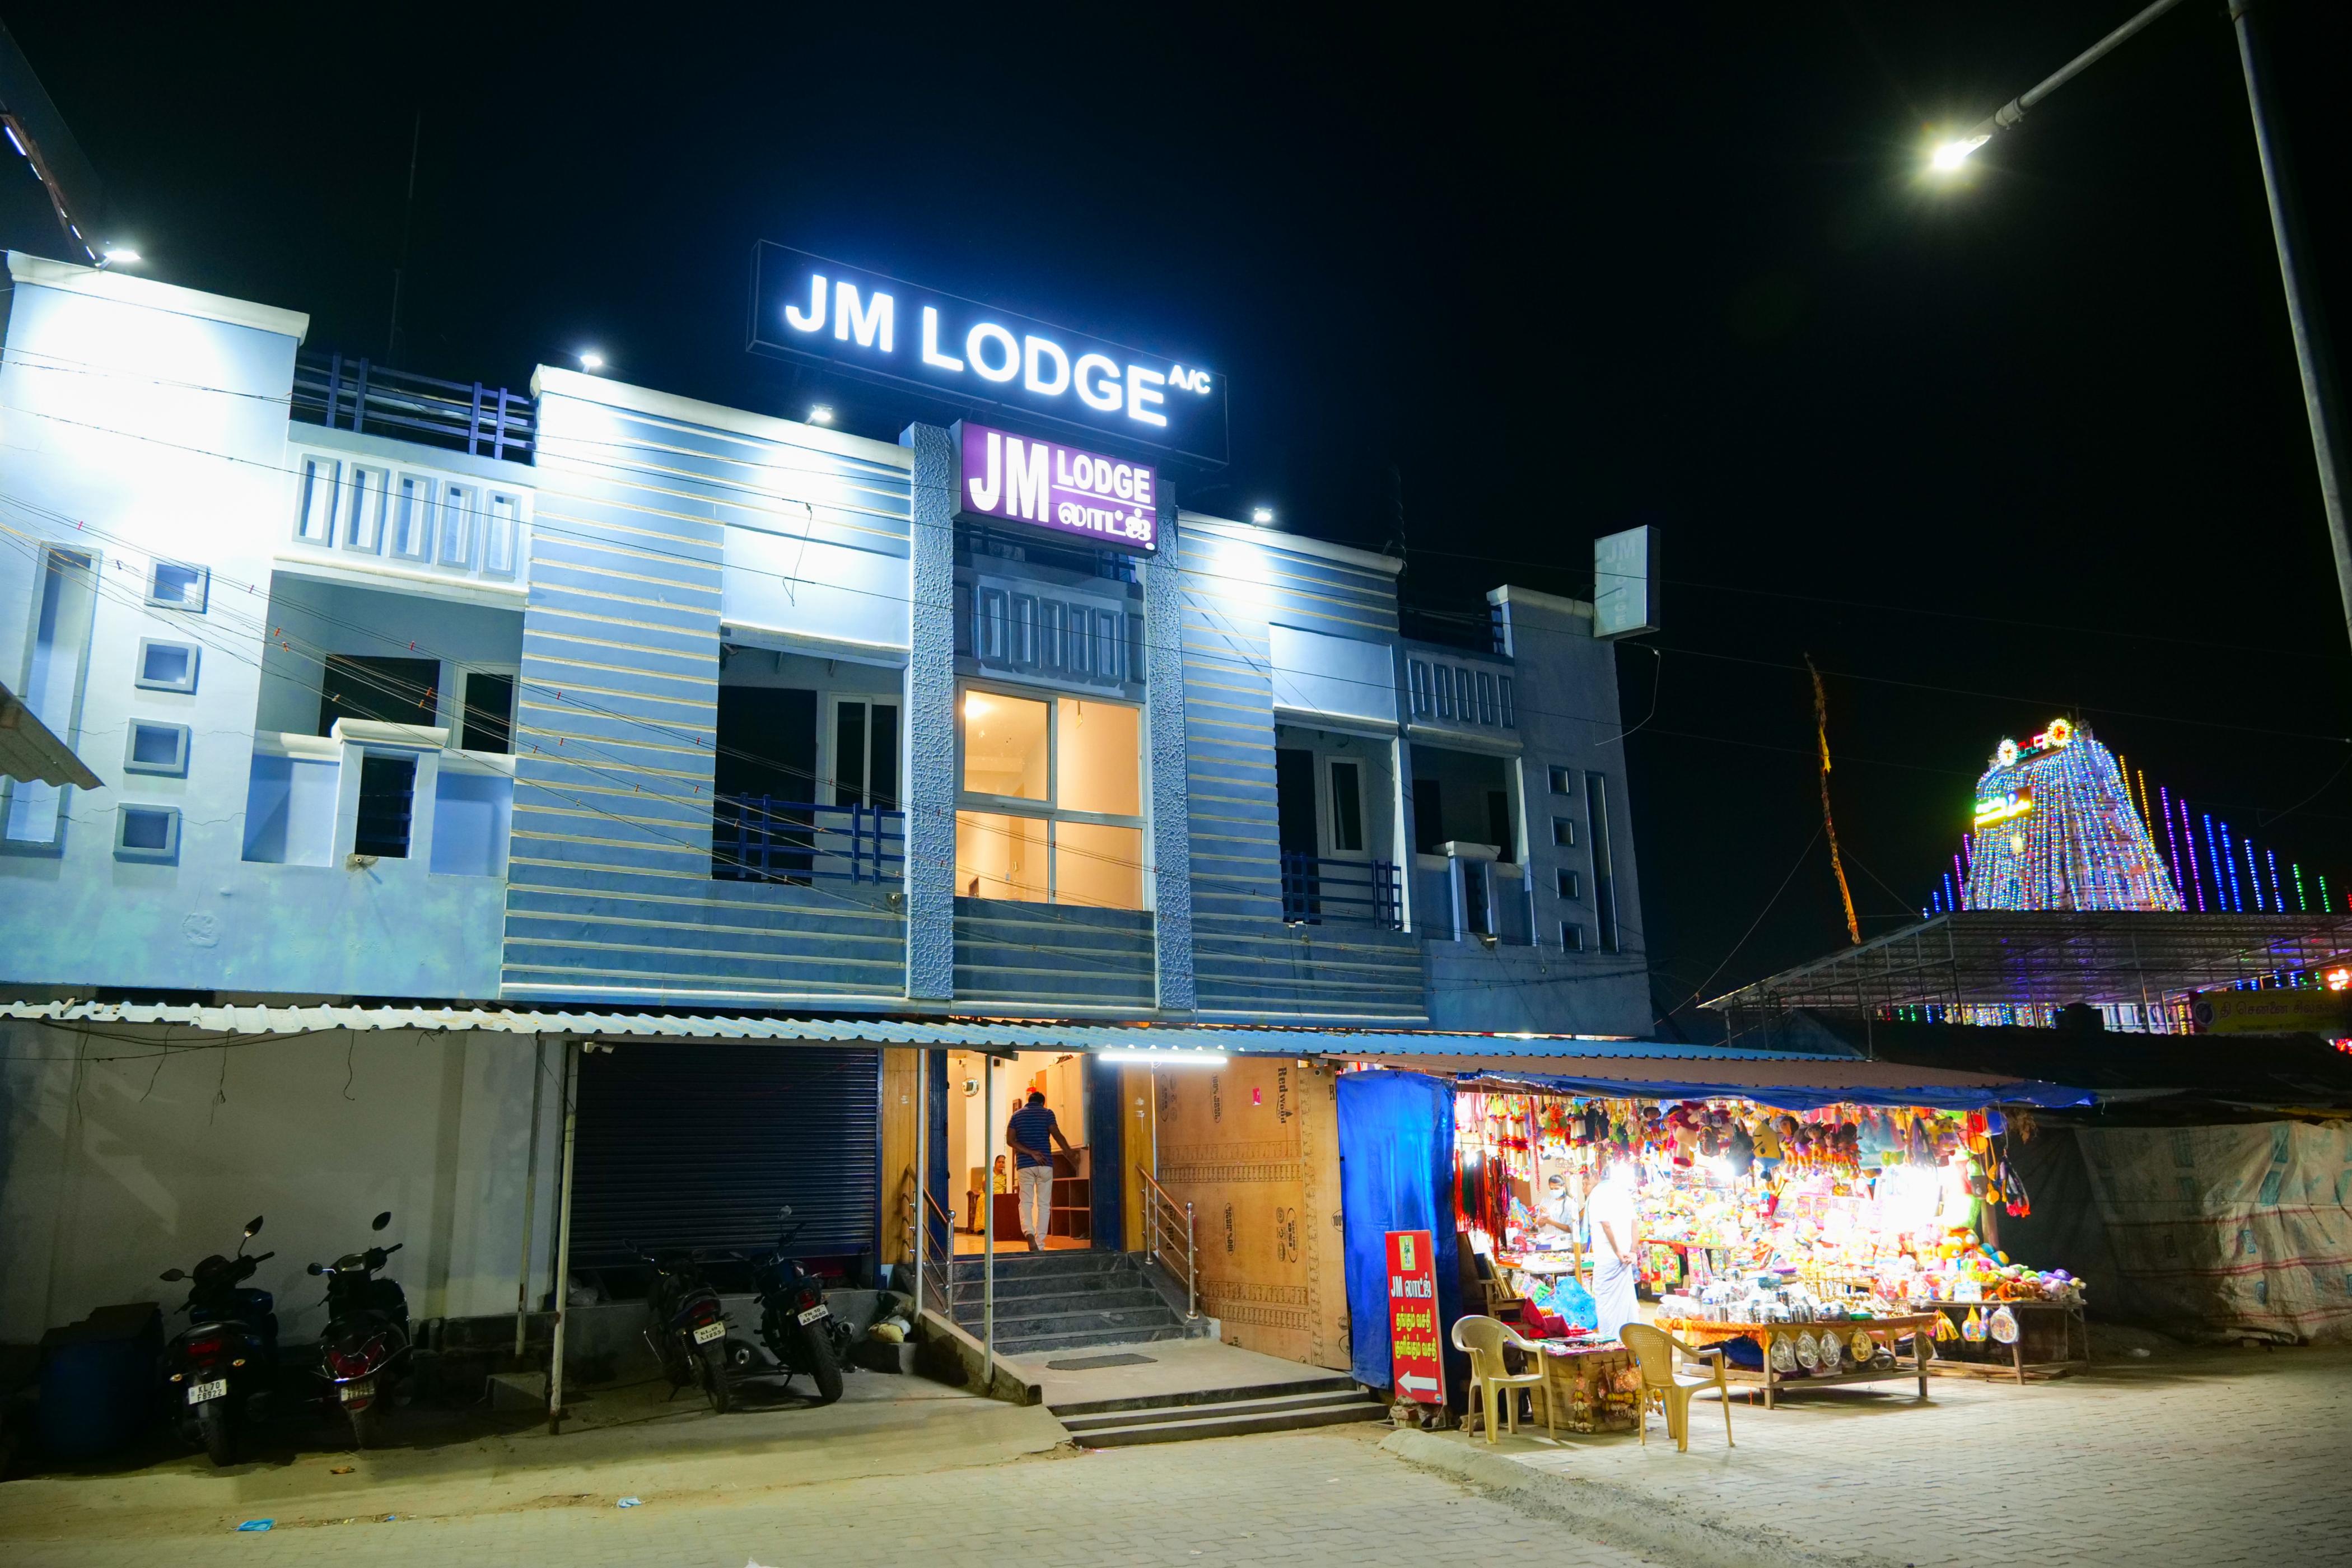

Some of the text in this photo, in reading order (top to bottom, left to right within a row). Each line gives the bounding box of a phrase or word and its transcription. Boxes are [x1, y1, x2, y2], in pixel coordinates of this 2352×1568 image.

[785, 274, 1211, 427] JM LODGE A/C
[969, 432, 1049, 522] JM
[1057, 450, 1151, 503] LODGE
[1606, 536, 1636, 563] JM
[1614, 563, 1627, 626] LODGE
[1391, 1271, 1432, 1299] JM லாட்ஜ்
[1416, 1308, 1431, 1333] வசதி
[1422, 1337, 1437, 1362] வசதி
[197, 1389, 222, 1402] F8922
[198, 1384, 208, 1393] KL
[210, 1382, 220, 1390] 70
